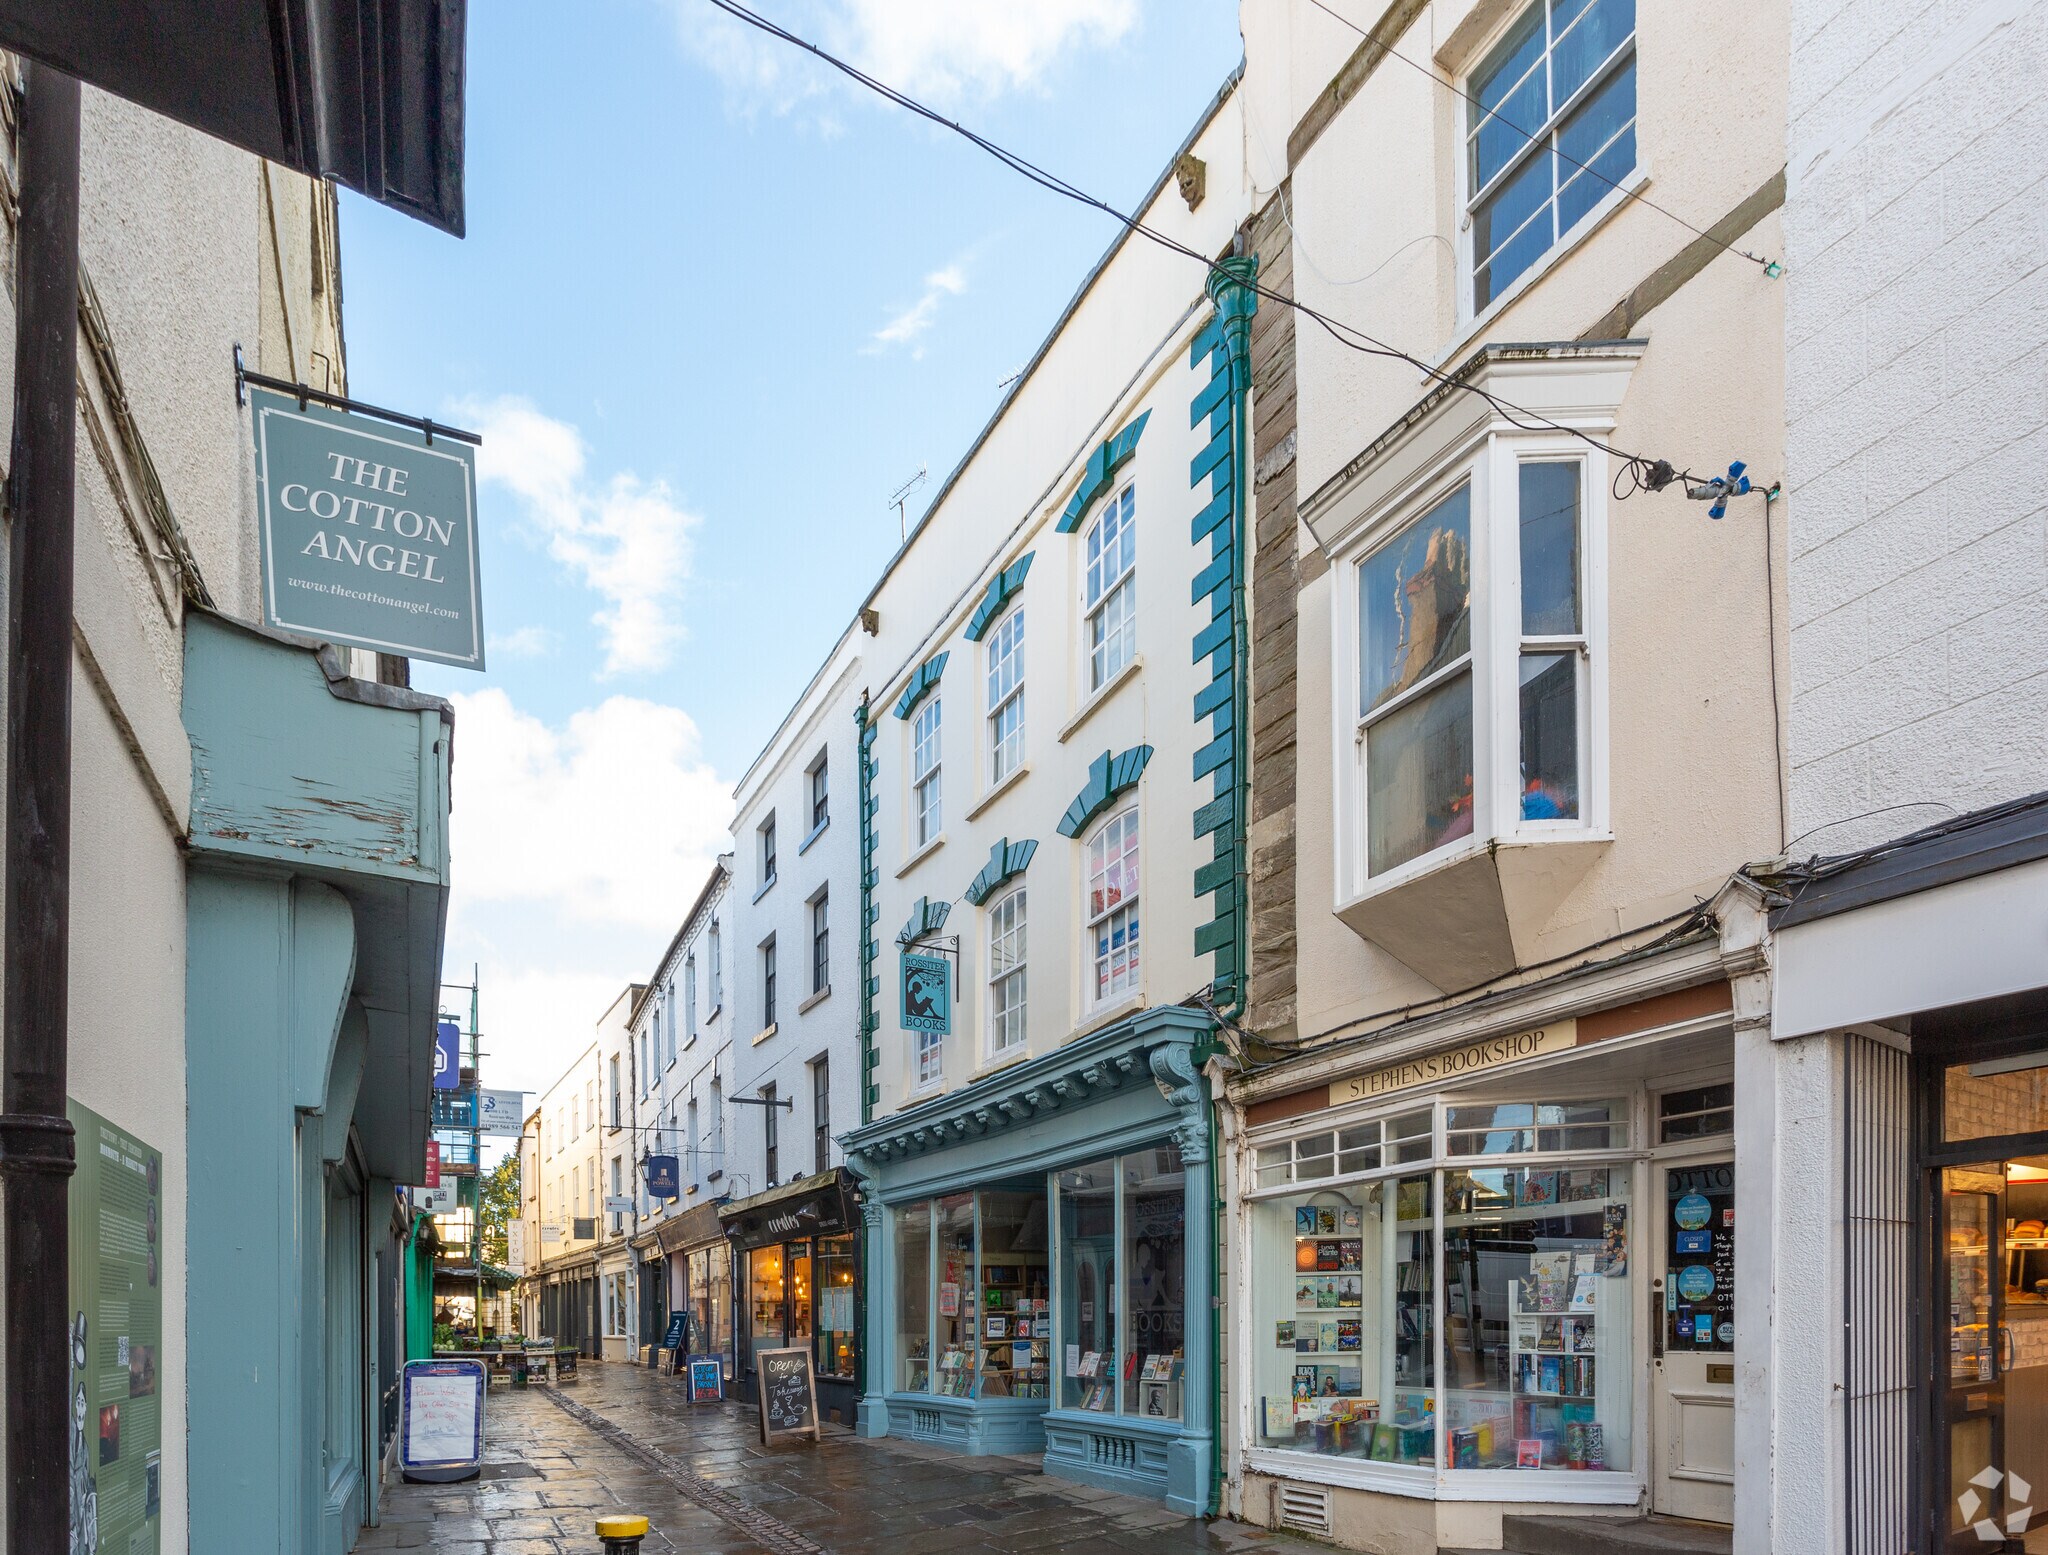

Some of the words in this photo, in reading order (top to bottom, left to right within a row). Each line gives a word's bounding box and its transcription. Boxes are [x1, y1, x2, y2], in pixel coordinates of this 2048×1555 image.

[328, 452, 409, 497] THE
[280, 483, 457, 547] COTTON
[300, 530, 445, 583] ANGEL
[287, 577, 460, 619] www.thecottonangel.com
[905, 957, 946, 972] ROSSITER
[905, 1016, 946, 1031] BOOKS
[1350, 1058, 1438, 1098] STEPHEN'S
[1442, 1030, 1545, 1075] BOOKSHOP
[1715, 1233, 1727, 1241] We
[674, 1320, 680, 1330] 2
